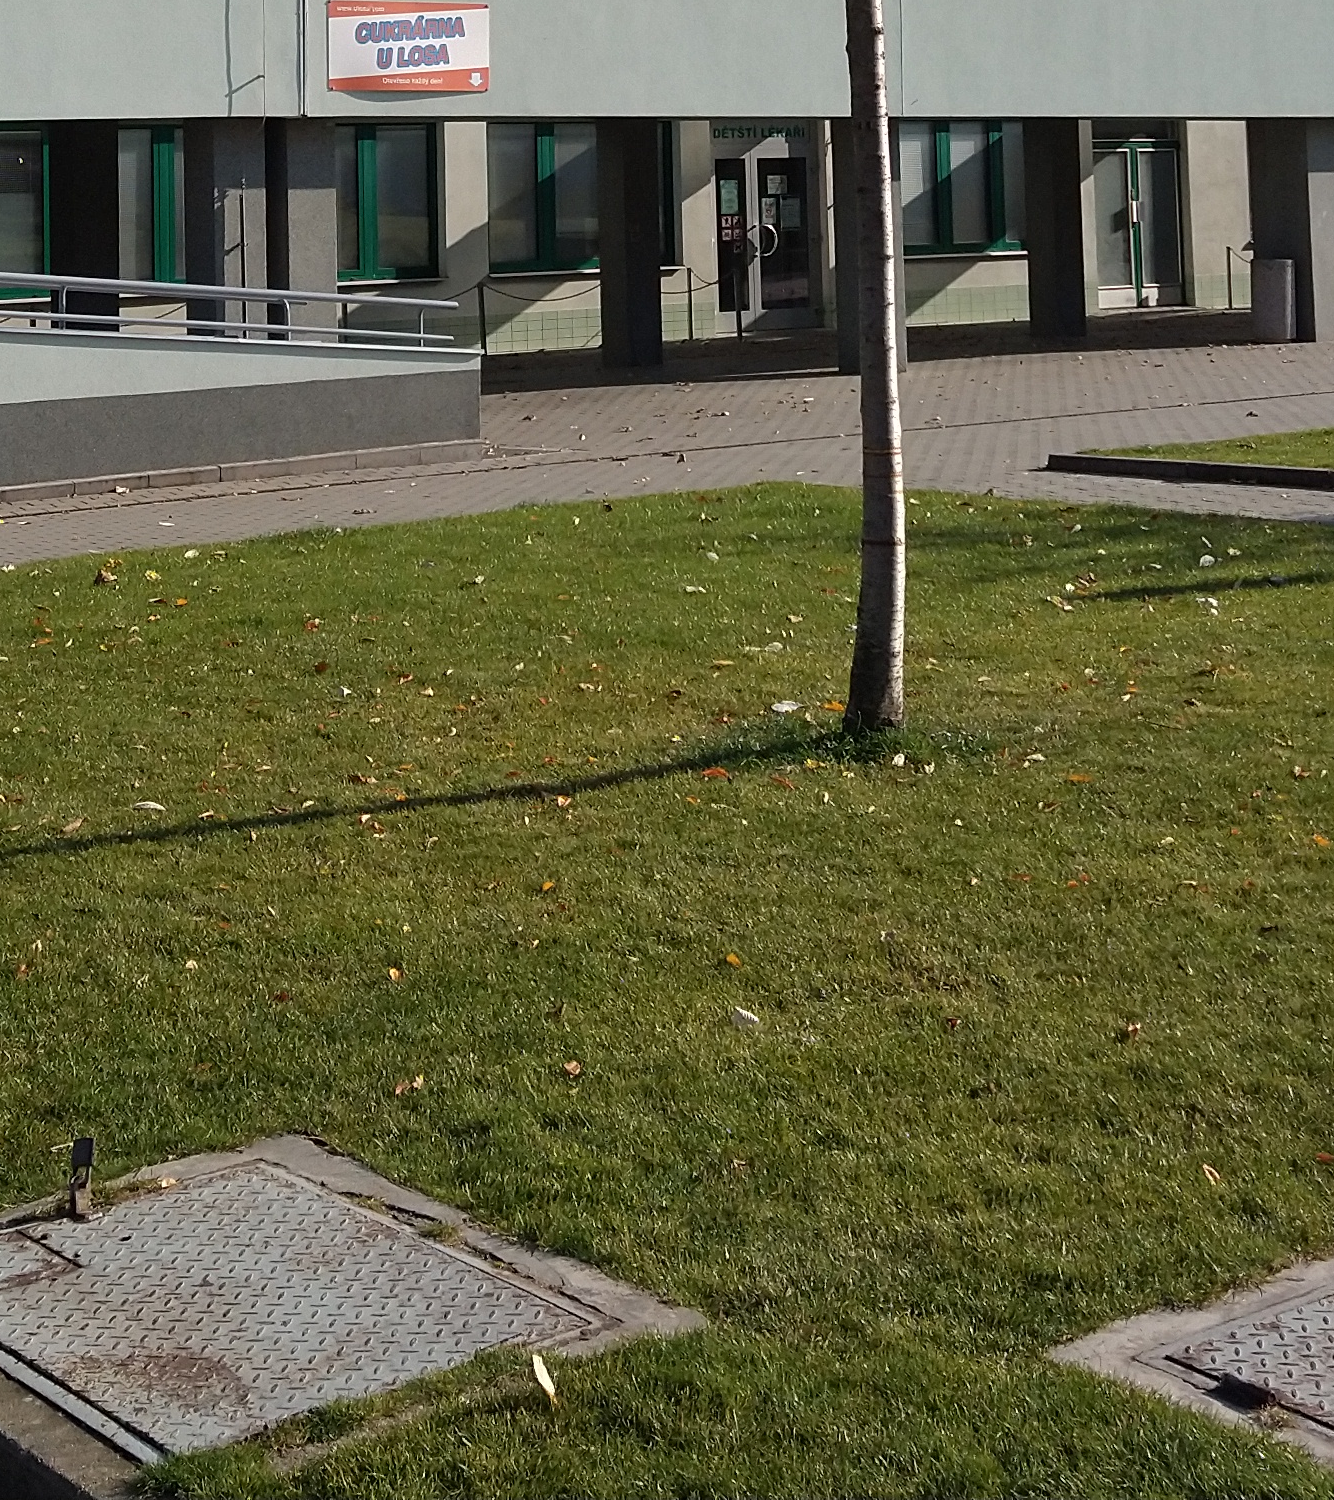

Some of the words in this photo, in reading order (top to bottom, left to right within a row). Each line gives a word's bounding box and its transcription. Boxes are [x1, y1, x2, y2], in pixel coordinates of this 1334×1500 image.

[355, 15, 465, 45] CUKRÁRNA
[377, 47, 393, 70] U
[396, 44, 450, 68] LOSA
